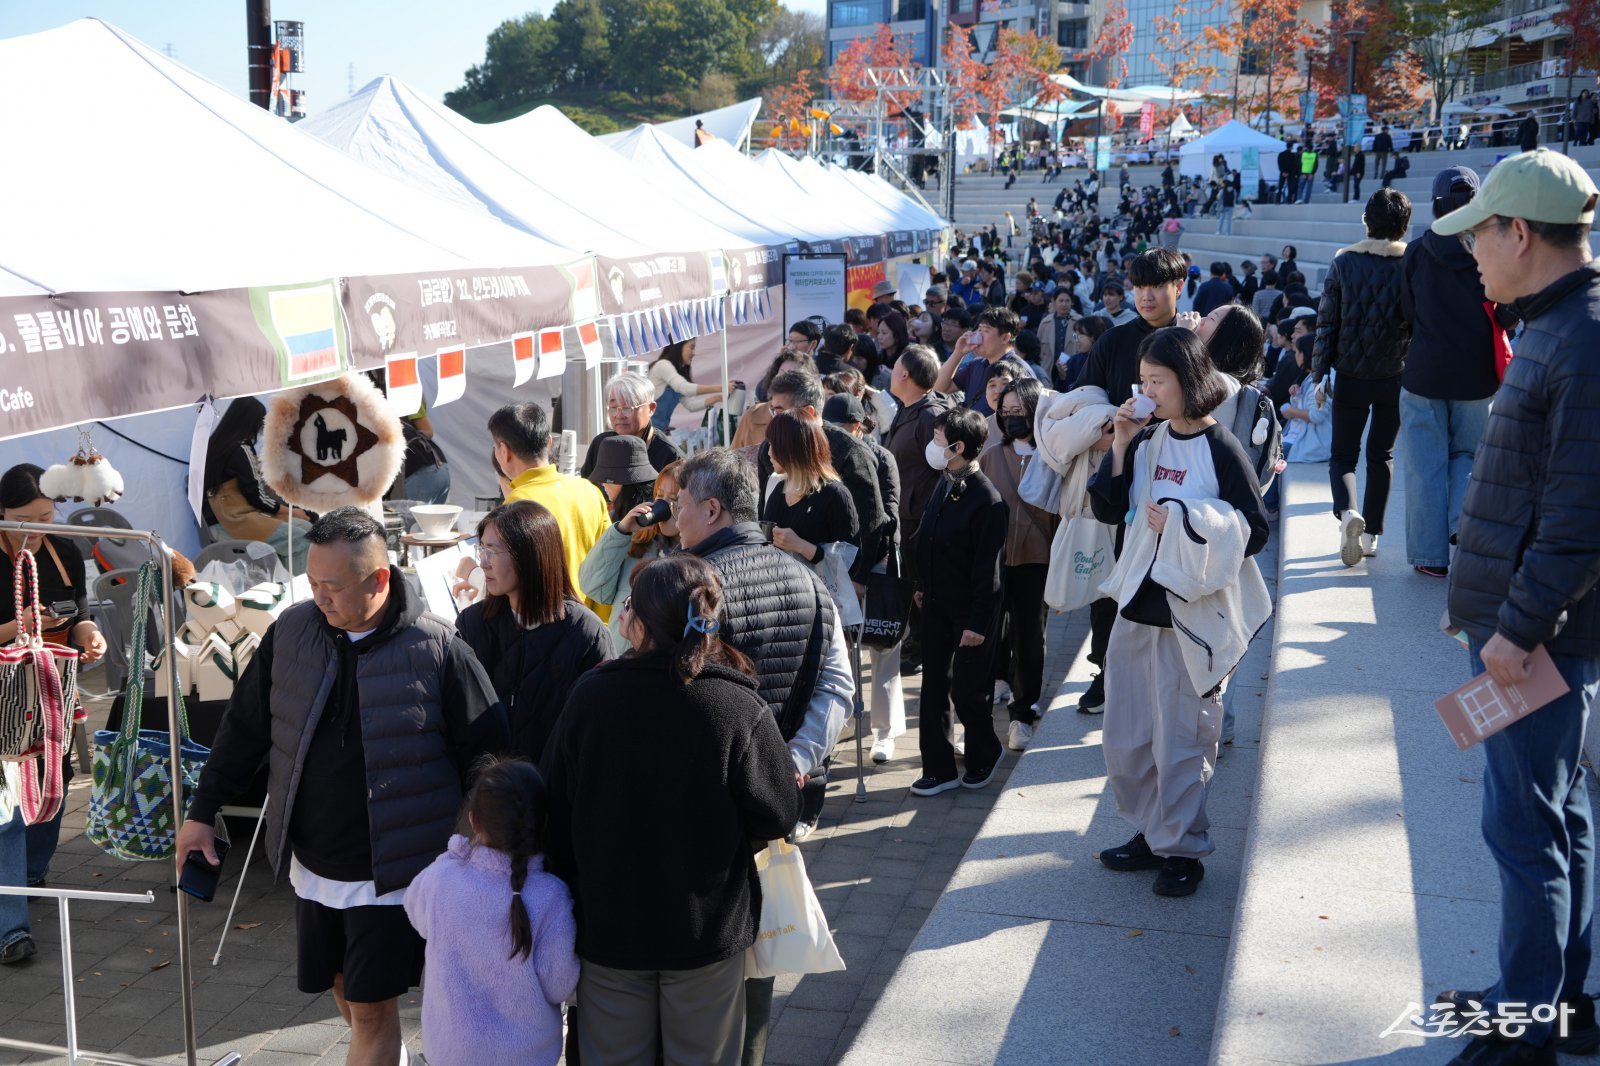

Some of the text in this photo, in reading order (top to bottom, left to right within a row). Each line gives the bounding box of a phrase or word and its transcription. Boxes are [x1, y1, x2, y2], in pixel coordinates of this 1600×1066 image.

[13, 308, 104, 353] 콜롬비아
[108, 306, 163, 345] 공예와
[163, 303, 199, 339] 문화
[0, 386, 34, 412] Cafe
